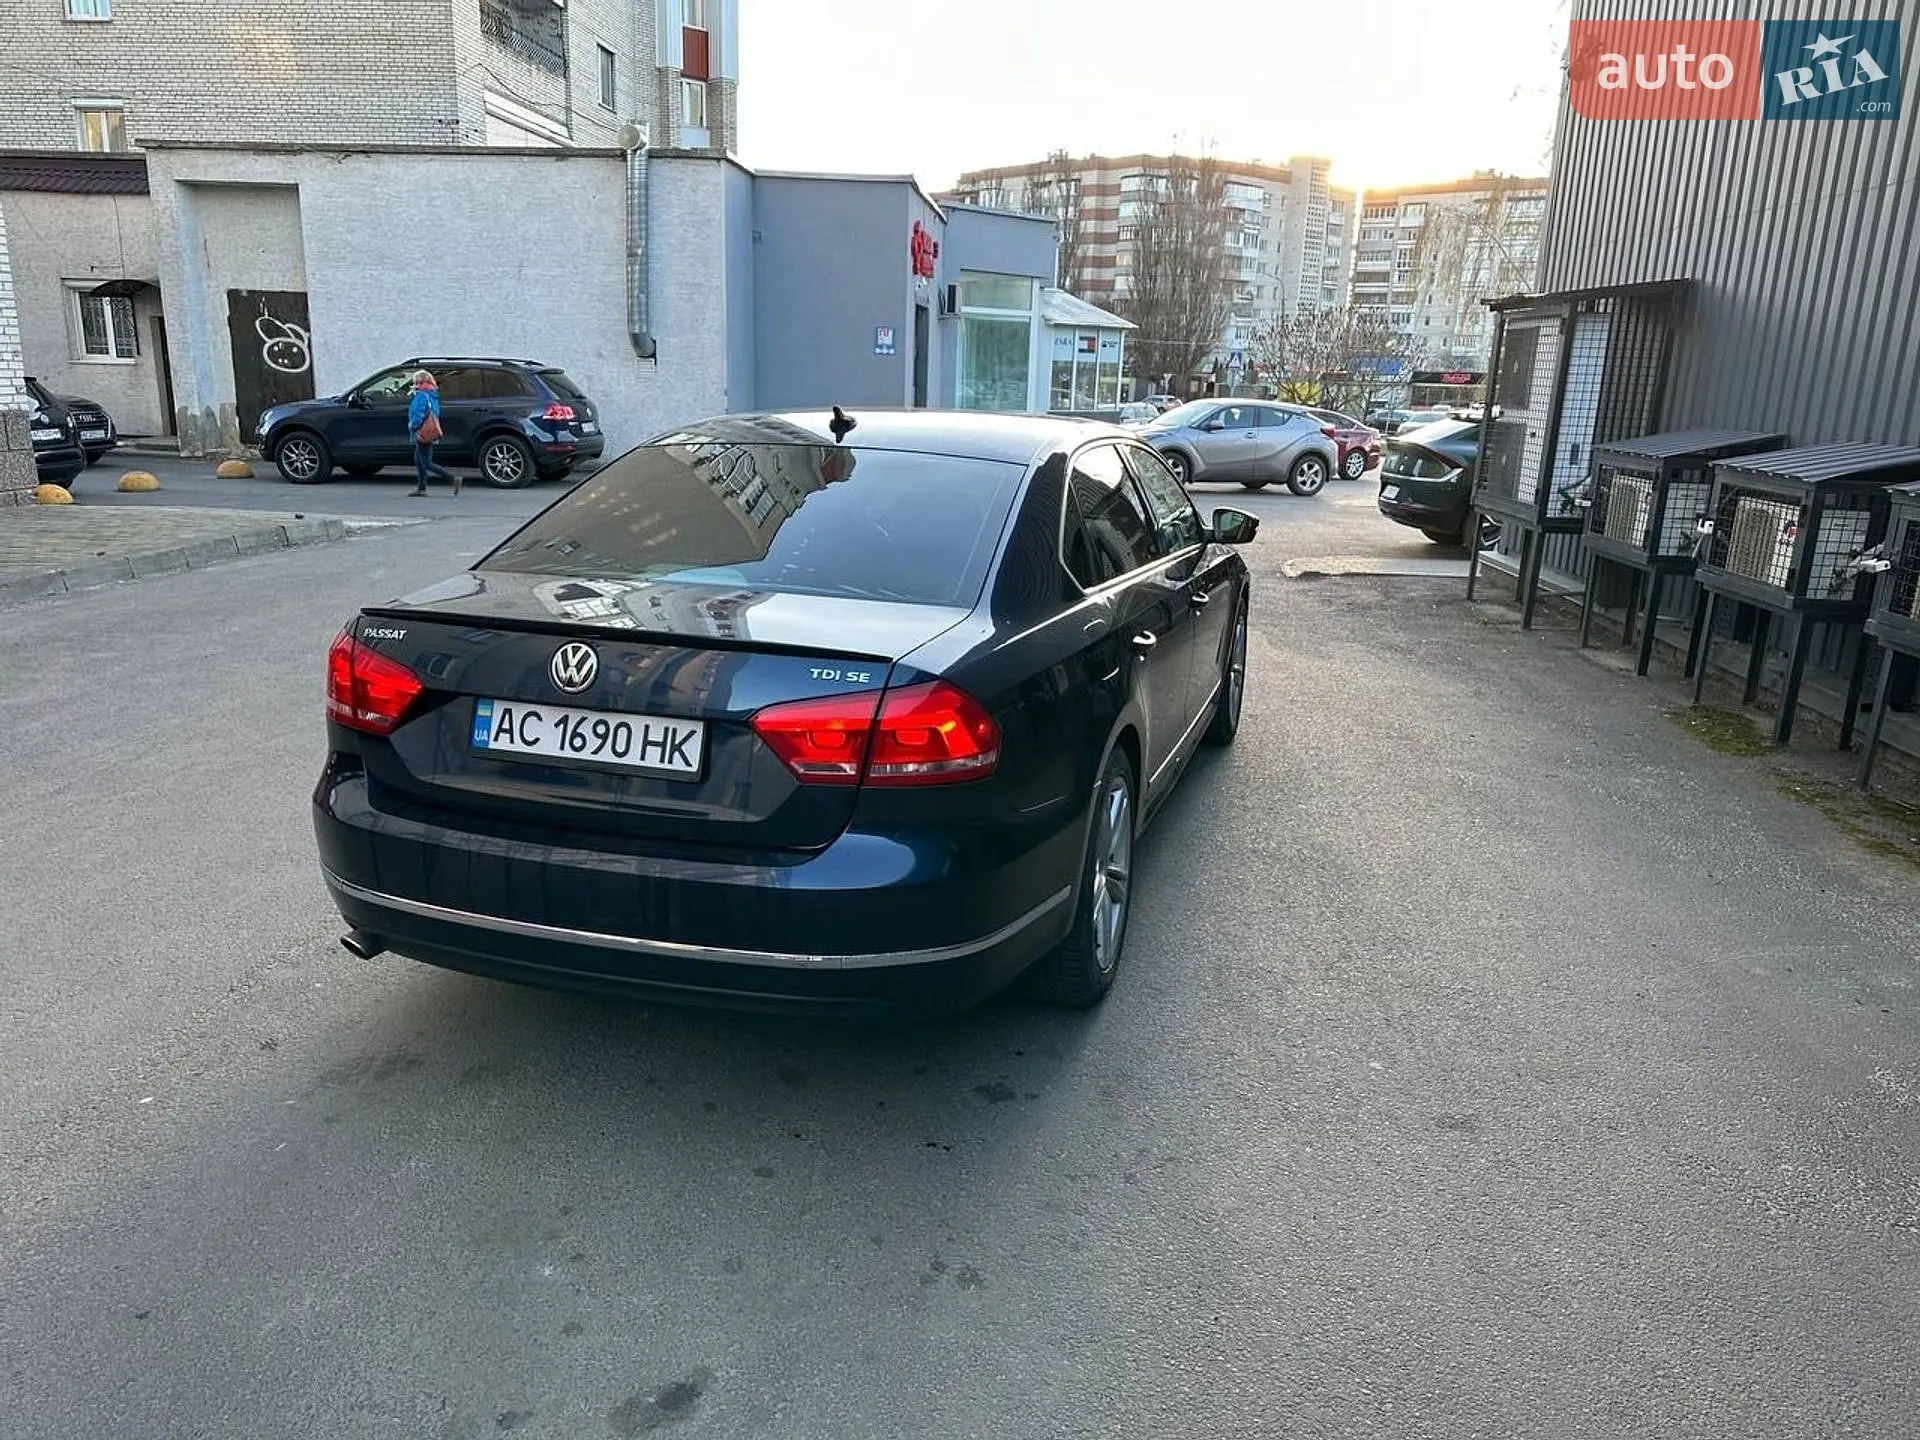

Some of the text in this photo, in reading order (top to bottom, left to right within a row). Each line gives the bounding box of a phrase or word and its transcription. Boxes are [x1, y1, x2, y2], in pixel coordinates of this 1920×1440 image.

[363, 628, 408, 640] PASSAT
[810, 668, 871, 683] TDI SE
[473, 729, 489, 742] UA
[493, 708, 698, 767] AC 1690 HK
